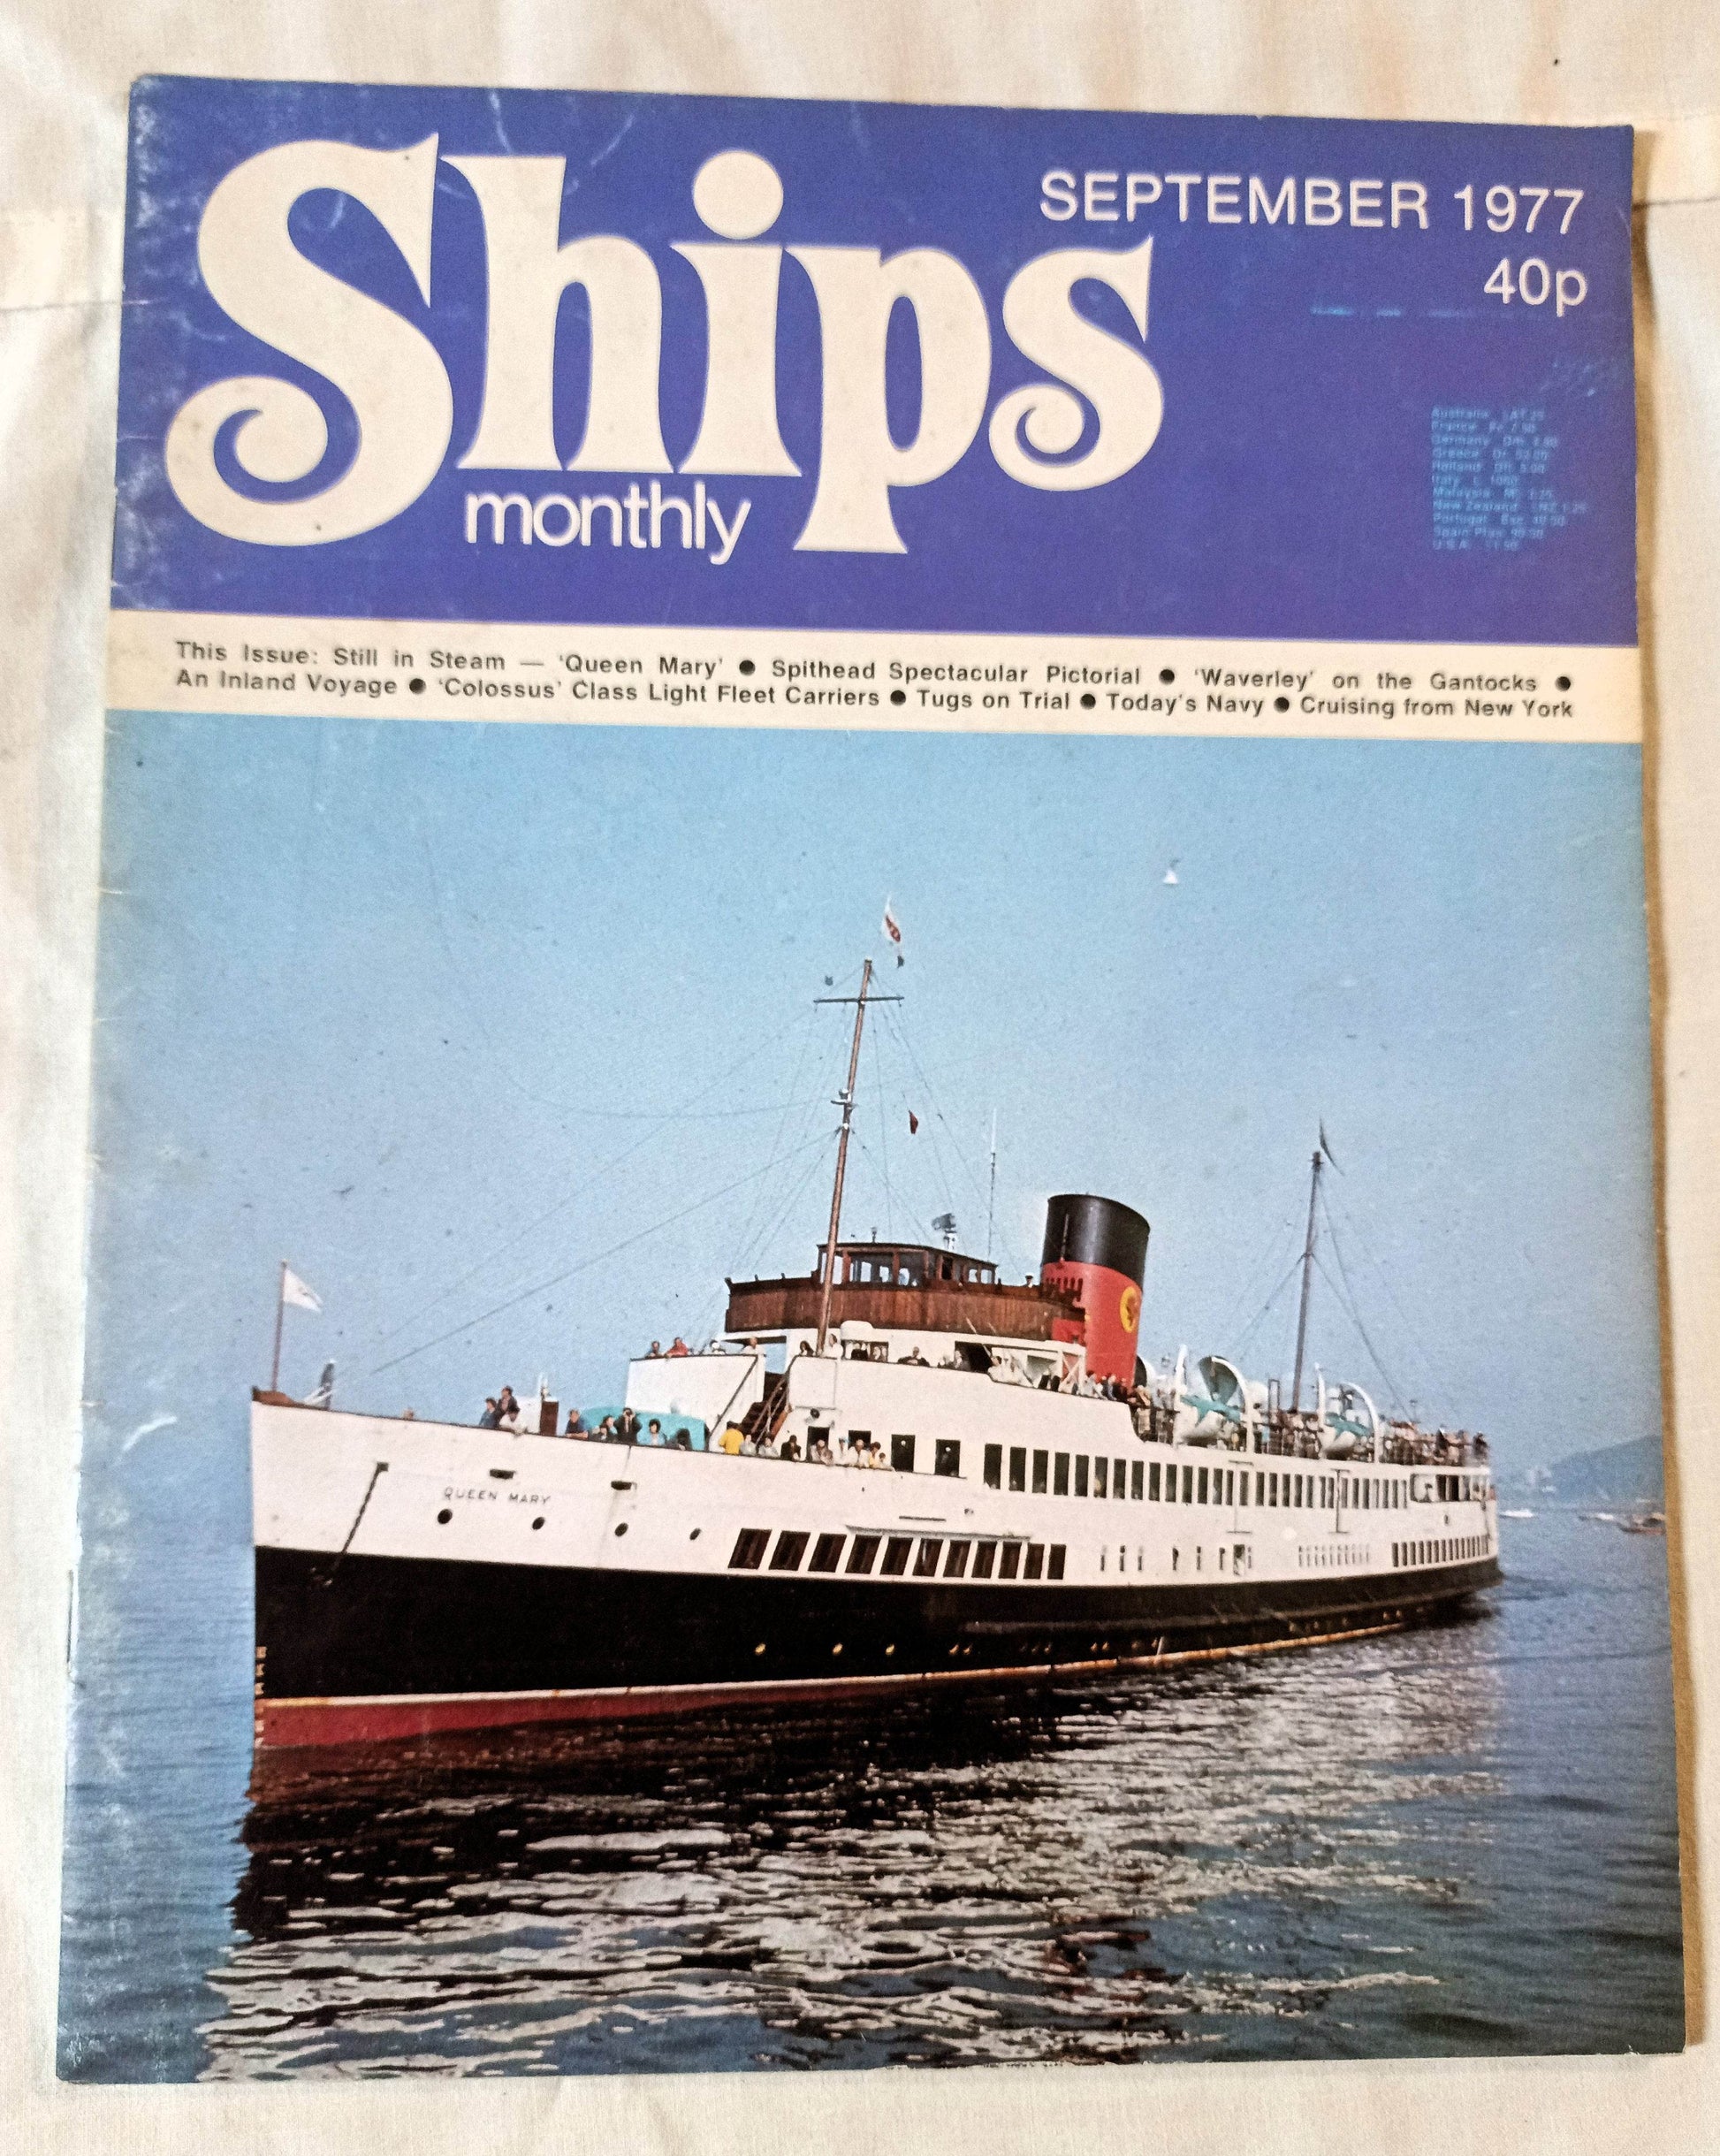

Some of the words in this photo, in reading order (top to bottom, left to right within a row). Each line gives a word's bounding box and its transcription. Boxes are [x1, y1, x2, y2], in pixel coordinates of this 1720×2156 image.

[1040, 171, 1428, 229] SEPTEMBER
[1454, 184, 1584, 235] 1977
[1484, 257, 1588, 317] 40p
[166, 133, 1162, 553] Ships
[465, 480, 751, 565] monthly
[176, 642, 226, 660] This
[245, 644, 317, 665] Issue:
[334, 648, 377, 667] Still
[395, 651, 414, 667] in
[430, 651, 505, 670] Steam
[772, 659, 874, 682] Spithead
[890, 662, 1027, 684] Spectacular
[1047, 665, 1140, 685] Pictorial
[1333, 675, 1358, 689] on
[1378, 673, 1412, 689] the
[1431, 673, 1537, 692] Gantocks
[177, 669, 208, 687] An
[221, 671, 294, 691] Inland
[308, 674, 396, 697] Voyage
[573, 680, 637, 700] Class
[650, 684, 706, 706] Light
[719, 685, 774, 704] Fleet
[786, 686, 879, 706] Carriers
[917, 689, 971, 712] Tugs
[983, 695, 1008, 709] on
[1020, 691, 1069, 710] Trial
[1207, 695, 1263, 717] Navy
[1301, 697, 1394, 720] Cruising
[1404, 698, 1454, 716] from
[1465, 699, 1513, 717] New
[1523, 700, 1572, 718] York
[444, 1487, 497, 1502] QUEEN
[508, 1493, 551, 1505] MARY
